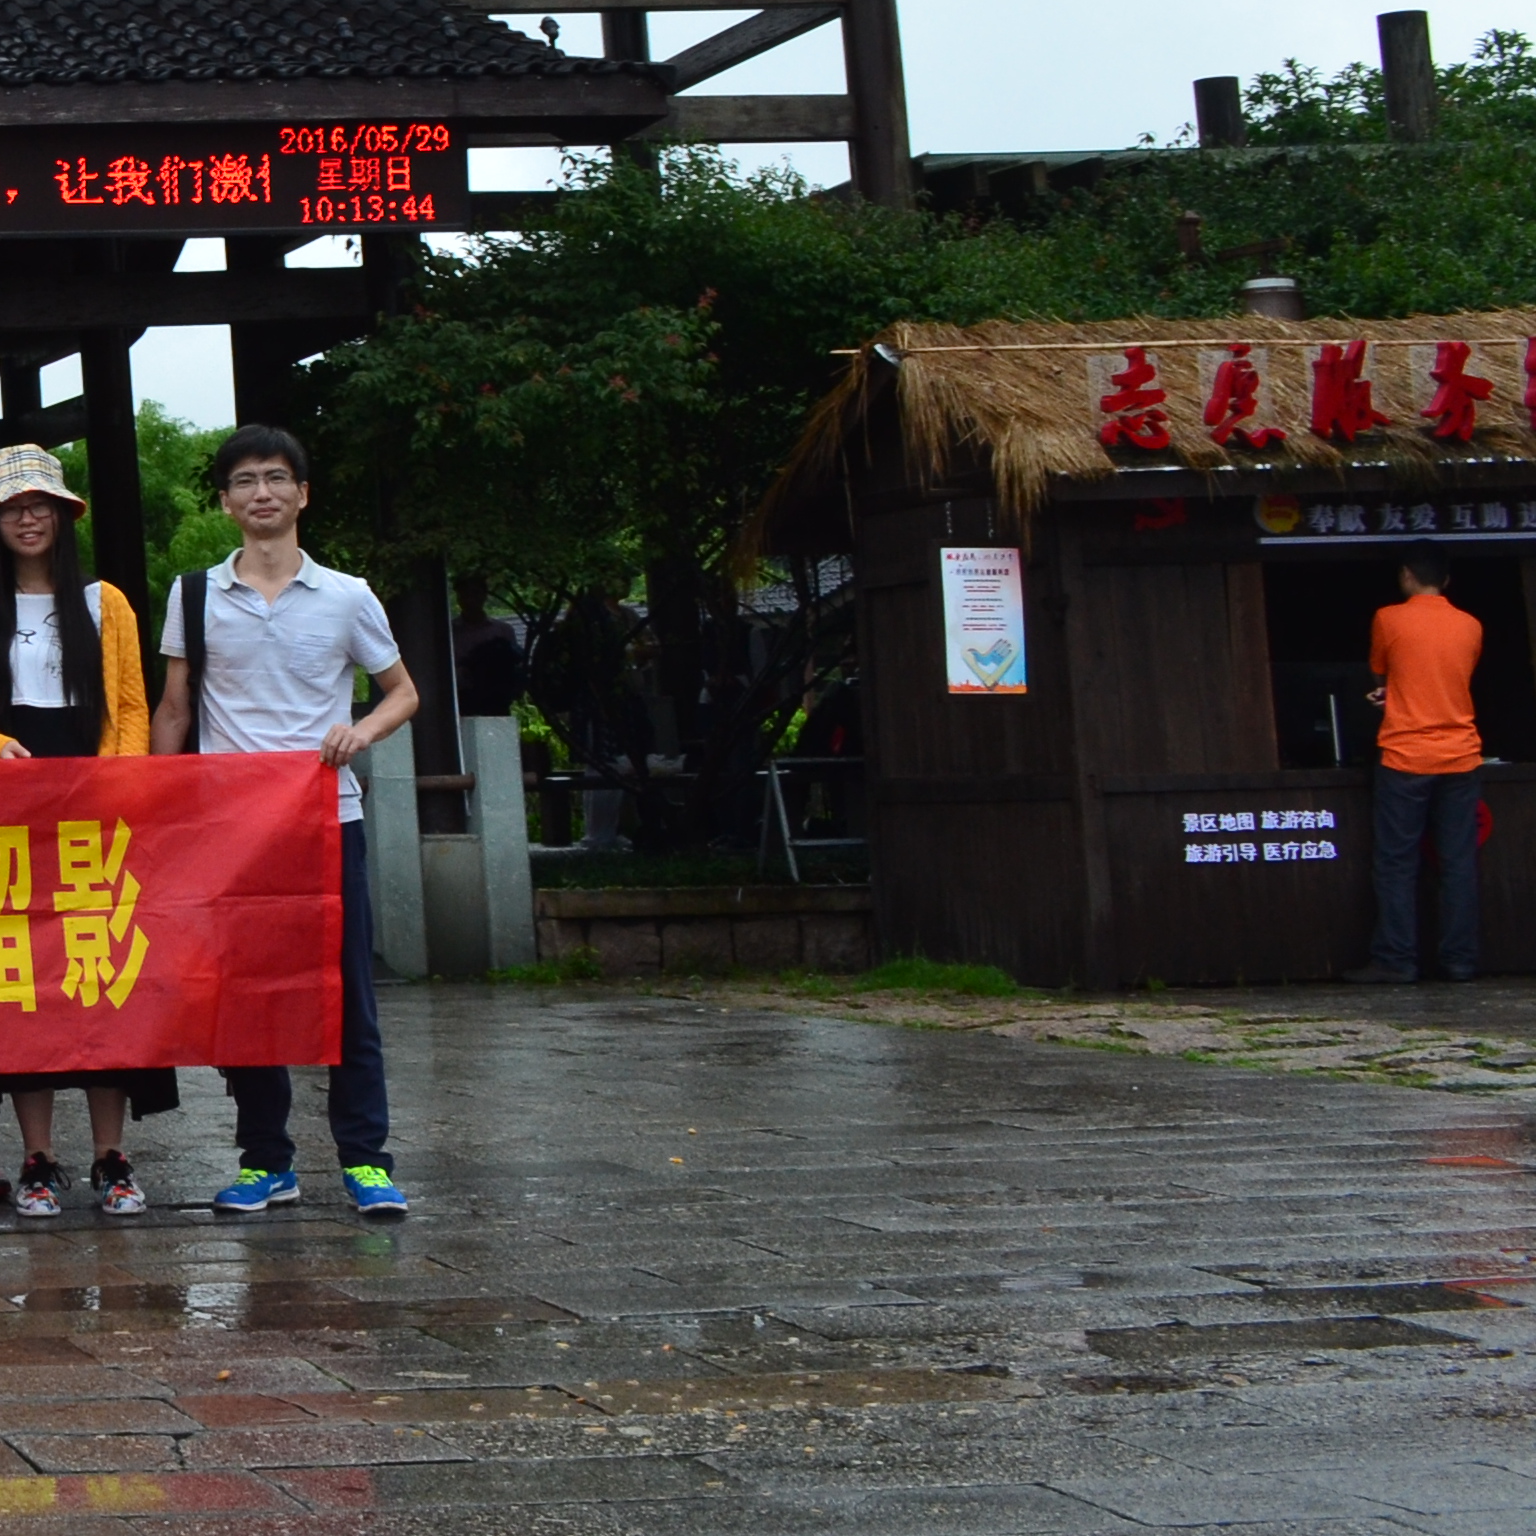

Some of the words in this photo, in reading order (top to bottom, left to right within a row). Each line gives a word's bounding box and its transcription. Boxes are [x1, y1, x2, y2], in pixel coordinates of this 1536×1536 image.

[278, 123, 451, 156] 2016/05/29
[316, 156, 412, 192] 星期日
[299, 193, 436, 224] 10:13:44
[1100, 339, 1536, 450] 志愿服务
[1182, 811, 1256, 833] 景区地图
[1260, 809, 1336, 830] 旅游咨询
[1184, 842, 1258, 863] 旅游引导
[1262, 839, 1338, 861] 医疗应急
